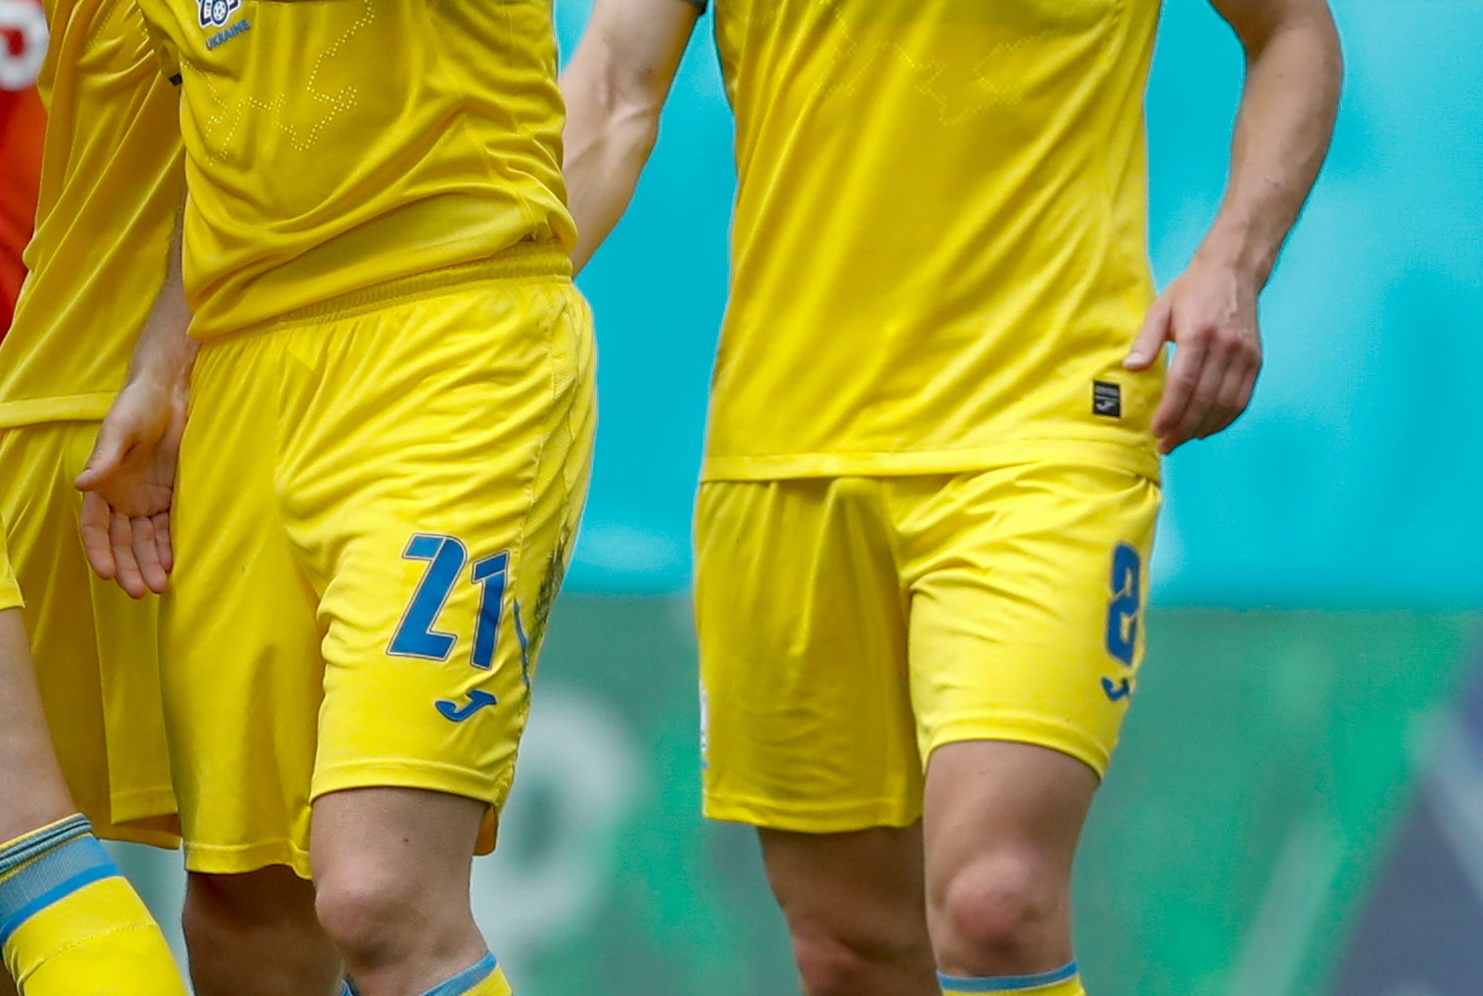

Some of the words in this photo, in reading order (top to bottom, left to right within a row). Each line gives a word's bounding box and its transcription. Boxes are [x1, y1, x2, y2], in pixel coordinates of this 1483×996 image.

[205, 17, 252, 51] UKRAINE
[386, 532, 510, 671] 21
[1104, 540, 1142, 668] 8
